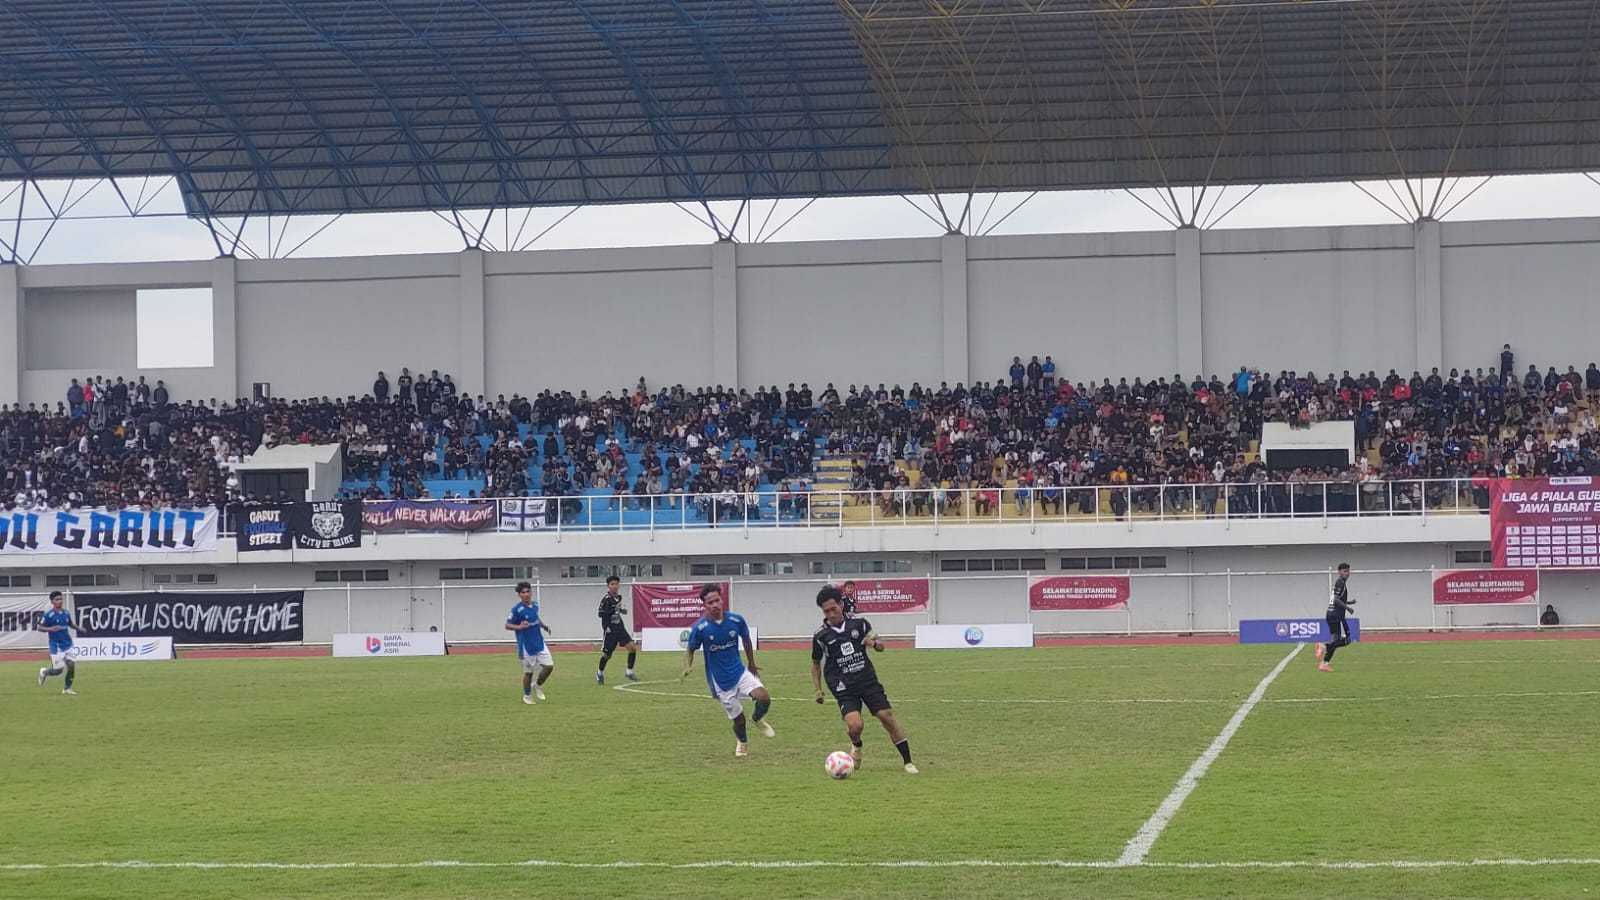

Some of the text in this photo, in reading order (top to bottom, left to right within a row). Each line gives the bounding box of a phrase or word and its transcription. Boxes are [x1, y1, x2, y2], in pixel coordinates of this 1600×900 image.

[1502, 492, 1527, 503] LIGA
[1530, 492, 1538, 502] 4
[1541, 491, 1574, 502] PIALA
[313, 502, 343, 513] GARUT
[394, 507, 428, 524] NEVER
[430, 507, 457, 524] WALK
[457, 505, 494, 524] ALONE
[1517, 503, 1550, 514] JAWA
[1553, 502, 1591, 513] BARAT
[249, 510, 281, 524] GARUT
[53, 511, 205, 549] GARUT
[249, 533, 283, 546] STREET
[300, 534, 321, 549] CITY
[171, 602, 243, 633] COMING
[243, 602, 300, 635] HOME
[1289, 622, 1321, 635] PSSI
[111, 641, 138, 658] bjb
